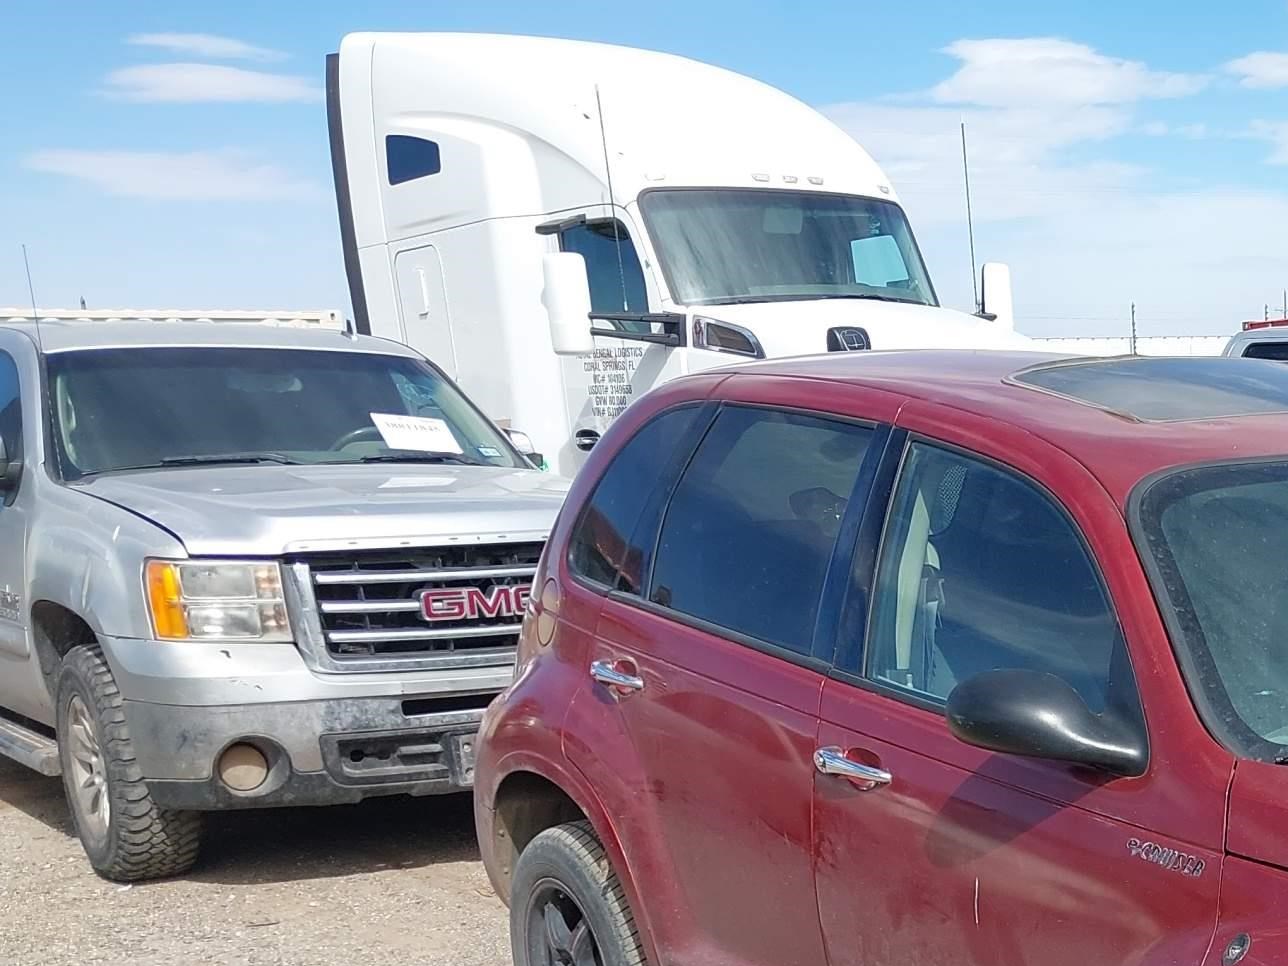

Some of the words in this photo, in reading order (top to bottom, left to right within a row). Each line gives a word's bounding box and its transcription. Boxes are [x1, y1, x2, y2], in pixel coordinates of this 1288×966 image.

[615, 347, 643, 358] LOGISTICS
[584, 361, 601, 371] CORAL
[602, 361, 625, 371] SPRINGS
[628, 360, 636, 370] FL
